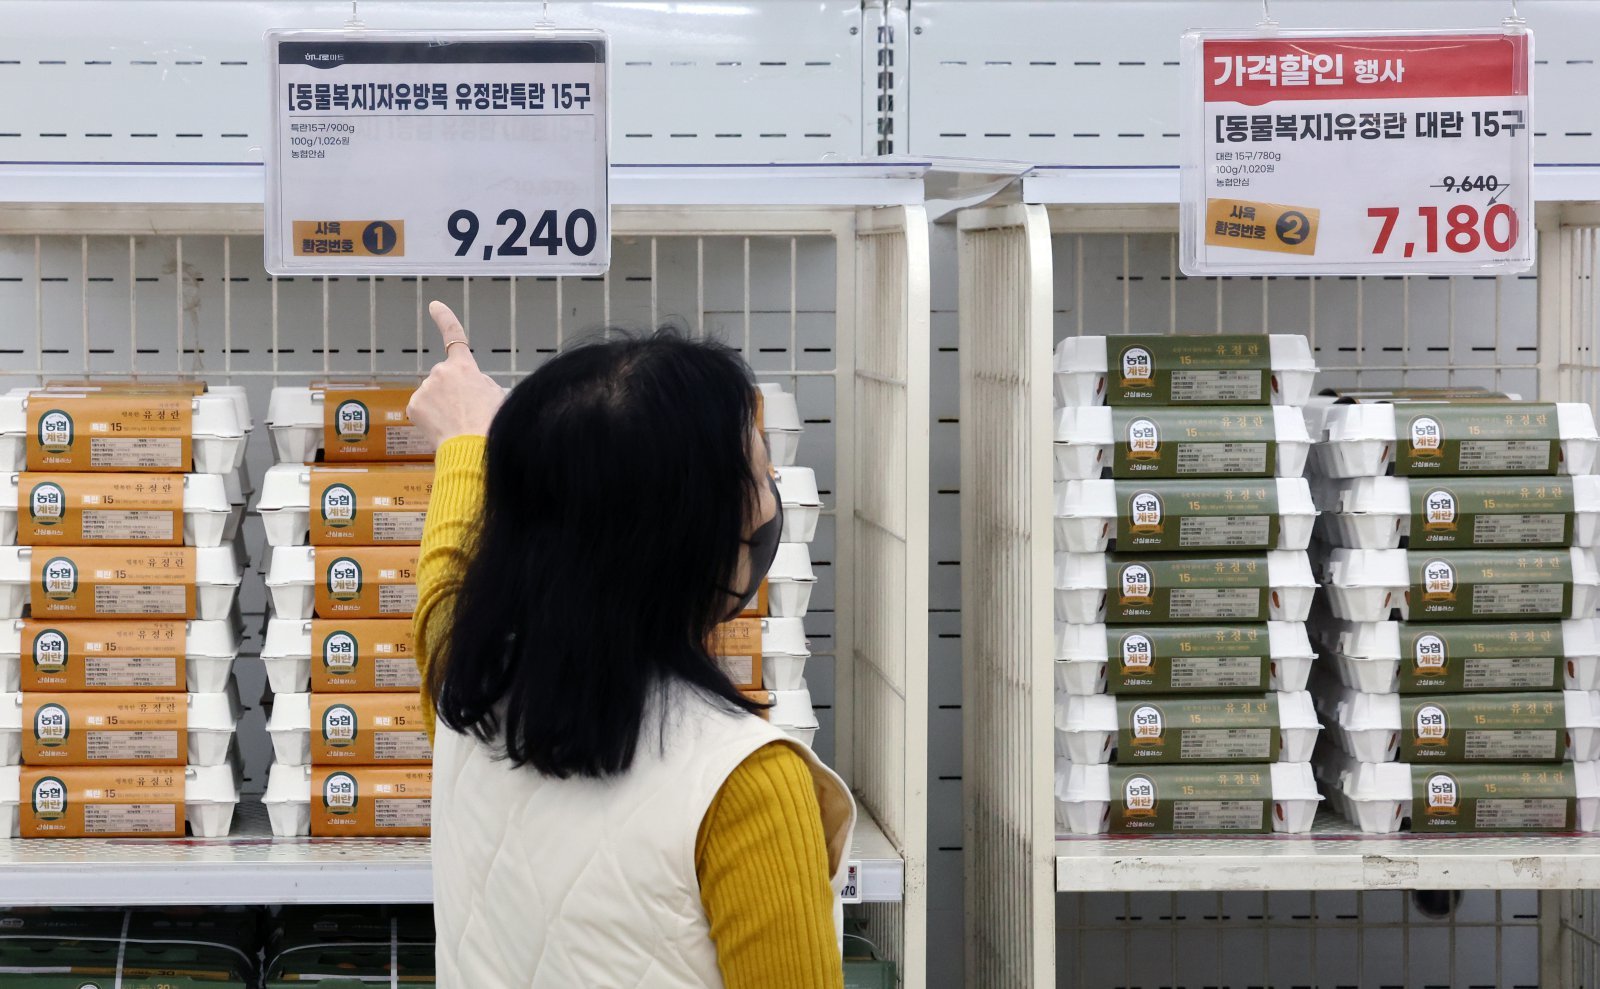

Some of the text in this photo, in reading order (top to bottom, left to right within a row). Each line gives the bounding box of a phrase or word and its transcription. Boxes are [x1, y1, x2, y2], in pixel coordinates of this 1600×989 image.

[304, 52, 344, 61] 하나로마트
[1214, 54, 1405, 87] 가격할인 행사
[288, 82, 591, 111] [동물복지]자유방목 유정란특란 15구
[290, 123, 355, 134] 특란15구/900g
[1215, 110, 1525, 143] [동물복지]유정란 대란 15구
[290, 136, 350, 147] 100g/1,026원
[290, 149, 325, 159] 농협안심
[1216, 151, 1281, 162] 대란 15구/780g
[1216, 164, 1275, 175] 100g/1,020원
[1216, 178, 1250, 188] 농협안심
[1443, 175, 1498, 194] 9,640
[1229, 205, 1256, 221] 사육
[315, 222, 341, 236] 사육
[1214, 220, 1267, 241] 환경번호
[1368, 204, 1519, 258] 7,180
[447, 208, 597, 261] 9,240
[302, 239, 354, 254] 환경번호
[1127, 355, 1148, 365] 농협
[1180, 356, 1191, 365] 15
[1127, 366, 1148, 376] 계란
[342, 410, 363, 421] 농협
[46, 421, 66, 432] 농협
[111, 423, 122, 431] 15
[342, 421, 363, 431] 계란
[1416, 425, 1436, 435] 농협
[1469, 426, 1480, 435] 15
[46, 432, 66, 442] 계란
[1133, 428, 1154, 437] 농협
[1186, 428, 1197, 437] 15
[1134, 438, 1154, 448] 계란
[1416, 436, 1437, 446] 계란
[37, 493, 58, 504] 농협
[103, 496, 114, 504] 15
[328, 495, 349, 506] 농협
[393, 497, 404, 505] 15
[1484, 499, 1495, 508] 15
[37, 504, 58, 514] 계란
[1136, 501, 1157, 511] 농협
[1189, 501, 1200, 510] 15
[1430, 499, 1451, 509] 농협
[328, 506, 349, 516] 계란
[1430, 510, 1451, 520] 계란
[1136, 512, 1157, 522] 계란
[50, 568, 70, 579] 농협
[115, 570, 126, 579] 15
[334, 568, 355, 579] 농협
[399, 570, 410, 578] 15
[1126, 573, 1147, 582] 농협
[1179, 573, 1190, 582] 15
[1428, 569, 1449, 578] 농협
[1482, 569, 1493, 578] 15
[50, 579, 70, 590] 계란
[334, 580, 355, 590] 계란
[1126, 584, 1147, 594] 계란
[1429, 580, 1450, 590] 계란
[40, 640, 61, 652] 농협
[105, 642, 116, 651] 15
[330, 642, 351, 653] 농협
[395, 644, 406, 652] 15
[1127, 642, 1148, 652] 농협
[1180, 642, 1191, 651] 15
[1420, 643, 1440, 653] 농협
[1473, 643, 1484, 652] 15
[40, 652, 61, 662] 계란
[330, 653, 351, 664] 계란
[1127, 654, 1148, 663] 계란
[1420, 654, 1441, 664] 계란
[42, 714, 62, 726] 농협
[107, 716, 118, 725] 15
[330, 715, 350, 726] 농협
[394, 717, 405, 725] 15
[1137, 714, 1158, 724] 농협
[1190, 714, 1201, 723] 15
[1421, 714, 1442, 724] 농협
[1474, 715, 1485, 724] 15
[41, 726, 62, 736] 계란
[330, 727, 350, 737] 계란
[1137, 725, 1158, 735] 계란
[1421, 726, 1442, 735] 계란
[330, 782, 351, 794] 농협
[395, 784, 406, 793] 15
[1130, 786, 1150, 795] 농협
[1182, 786, 1194, 795] 15
[1432, 783, 1452, 793] 농협
[1485, 784, 1496, 793] 15
[39, 788, 60, 799] 농협
[105, 789, 116, 798] 15
[39, 799, 60, 809] 계란
[330, 794, 351, 804] 계란
[1130, 796, 1151, 806] 계란
[1432, 794, 1453, 804] 계란
